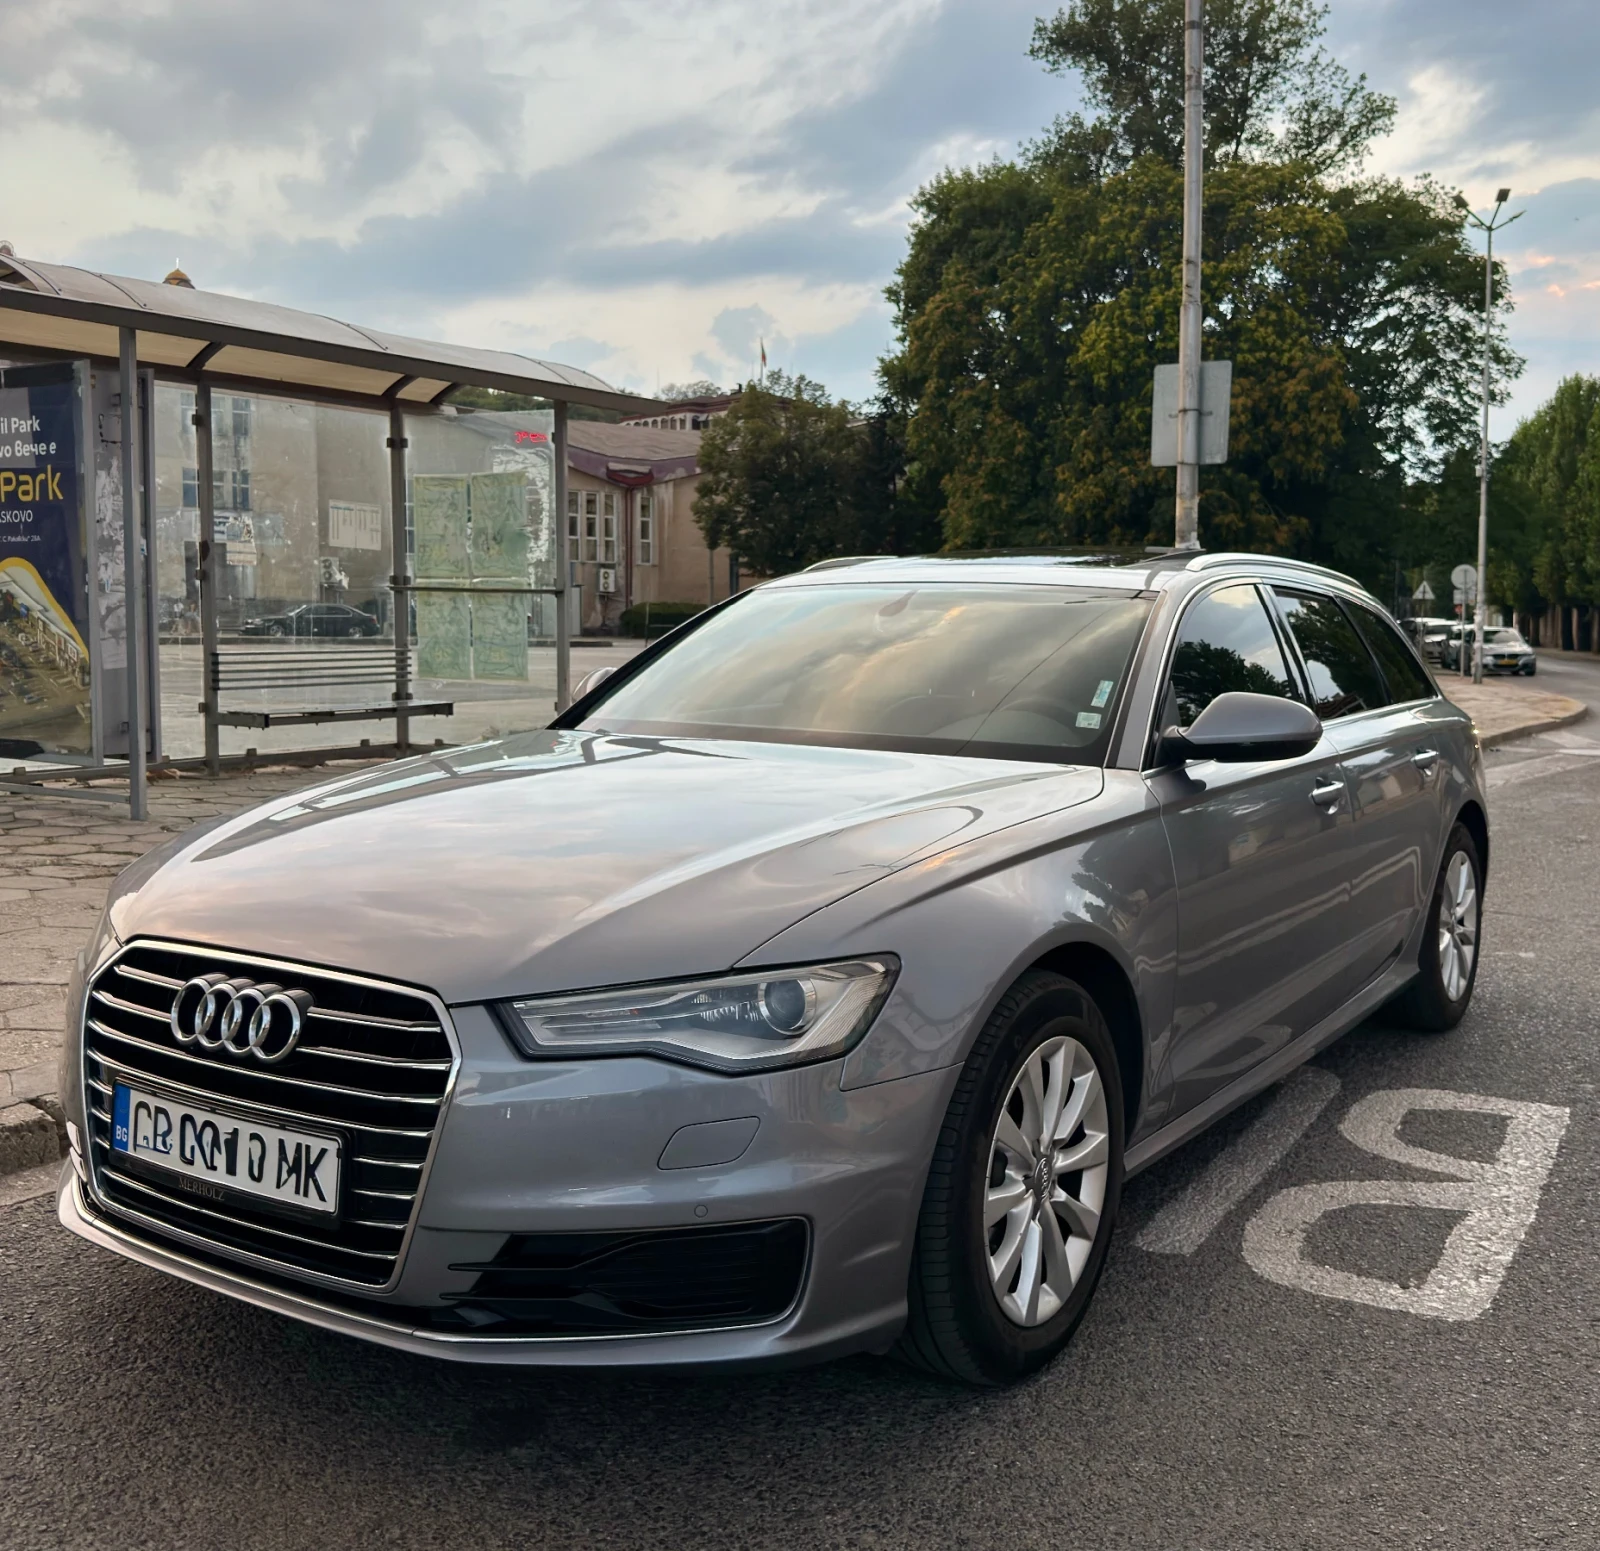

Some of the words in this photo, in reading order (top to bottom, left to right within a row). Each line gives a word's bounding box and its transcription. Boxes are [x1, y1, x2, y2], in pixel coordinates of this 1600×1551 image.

[11, 415, 41, 434] Park
[0, 464, 63, 502] Park
[0, 509, 33, 523] SKOVO
[116, 1125, 128, 1142] BG
[178, 1175, 225, 1201] MERHOLZ
